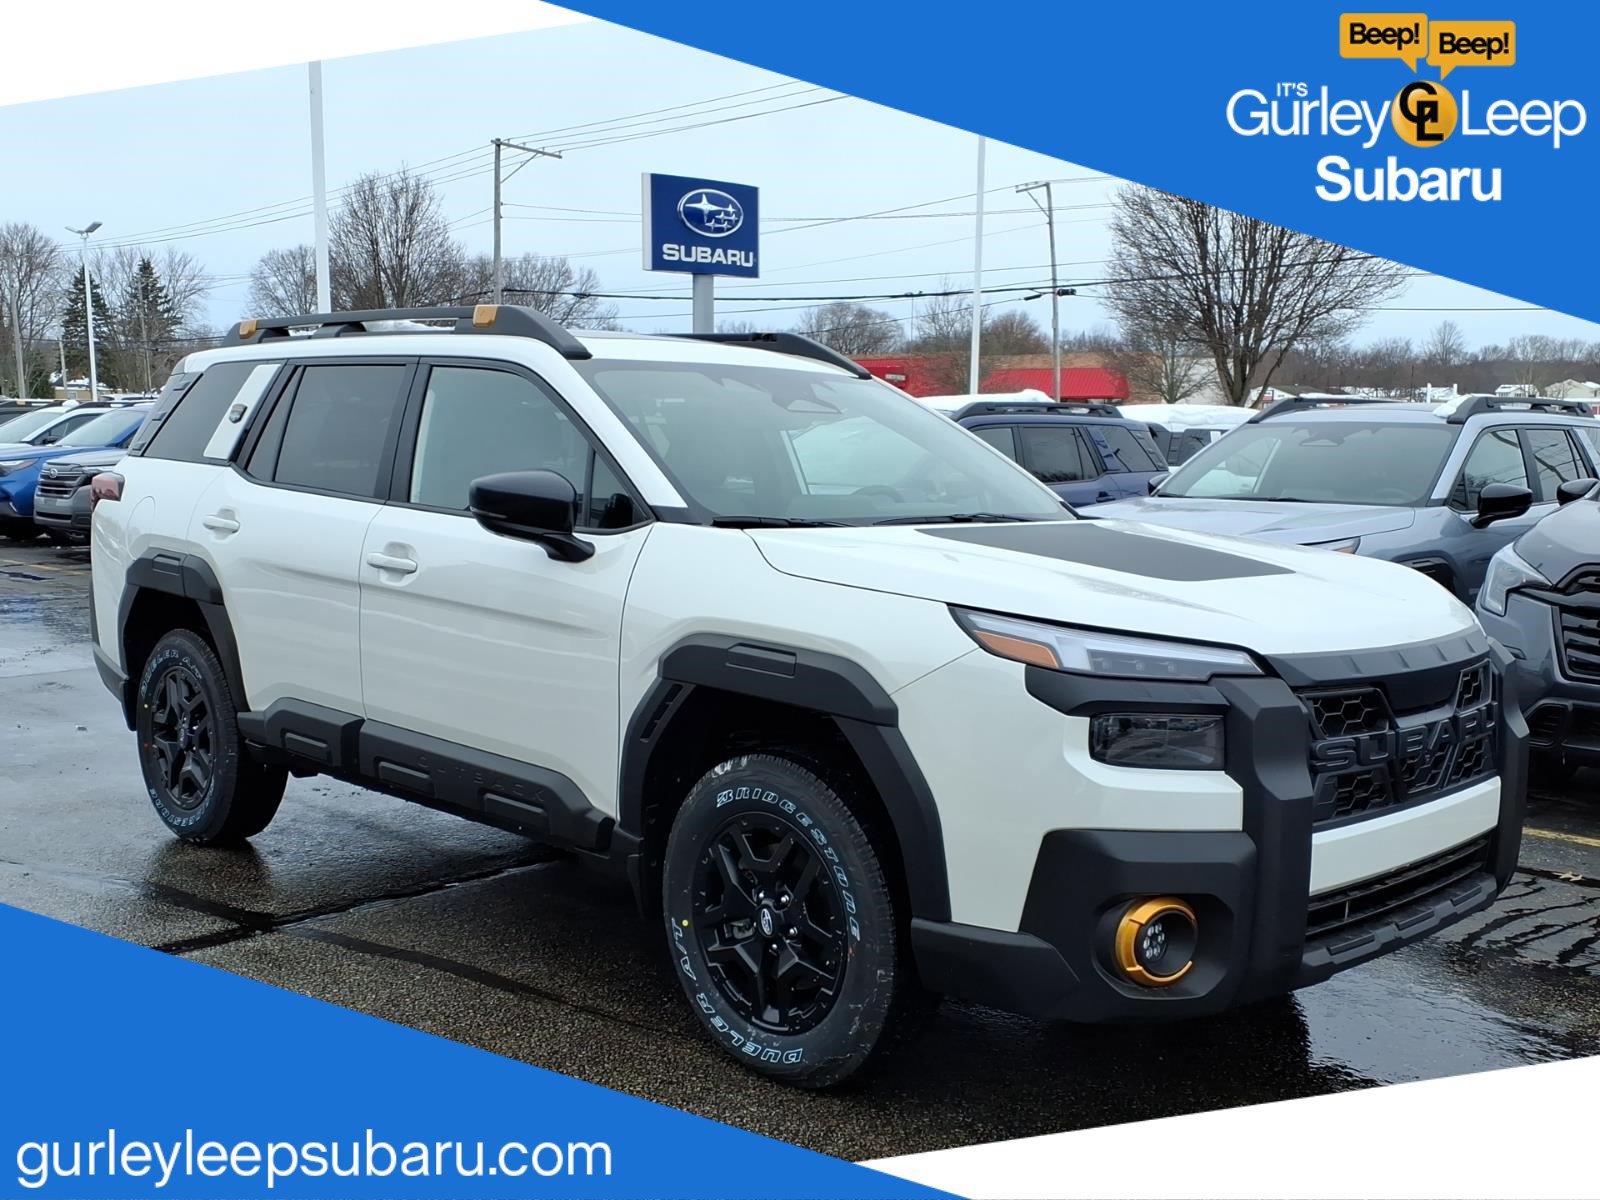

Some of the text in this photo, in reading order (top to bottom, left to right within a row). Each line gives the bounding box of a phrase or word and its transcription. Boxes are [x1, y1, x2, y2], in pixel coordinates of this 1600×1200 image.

[662, 243, 754, 268] SUBARU
[1311, 701, 1498, 768] SUBARU
[715, 786, 861, 942] BRIDGESTONE
[695, 992, 803, 1065] DUELER
